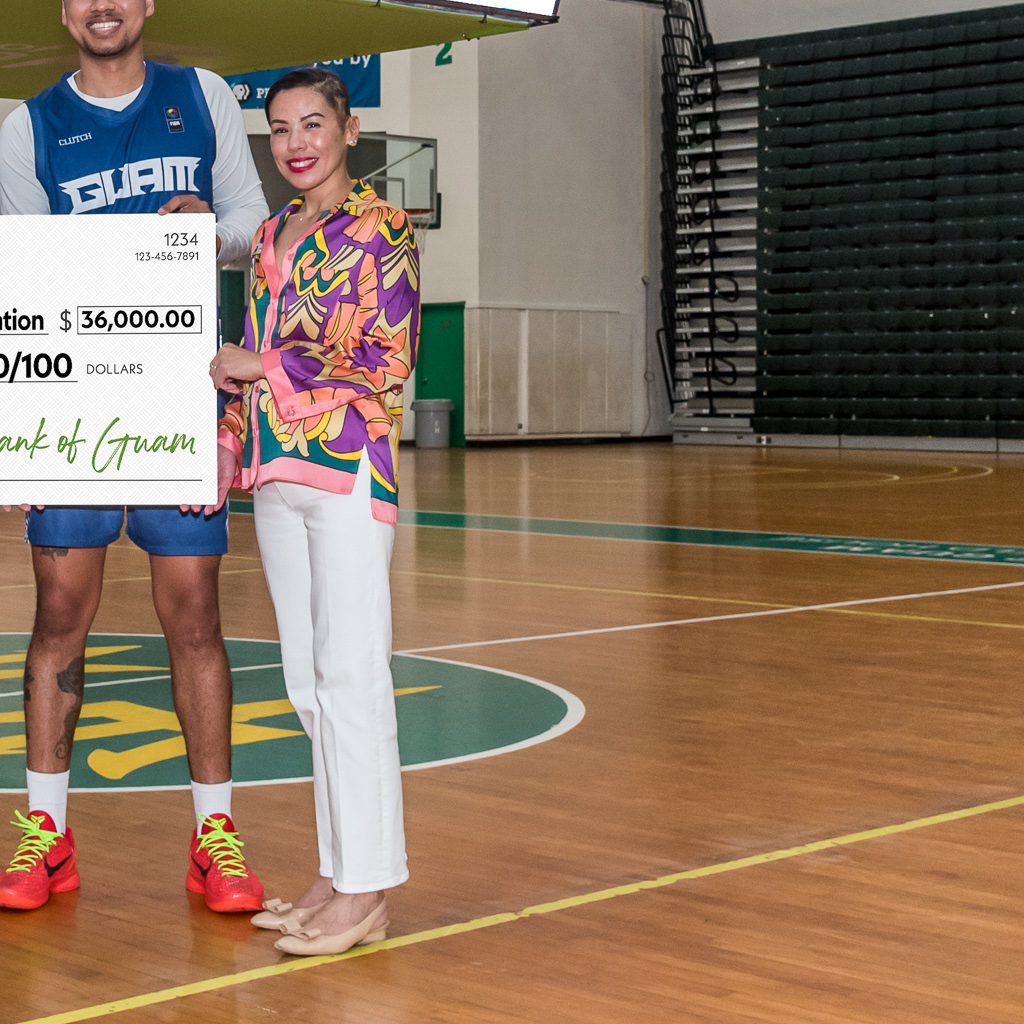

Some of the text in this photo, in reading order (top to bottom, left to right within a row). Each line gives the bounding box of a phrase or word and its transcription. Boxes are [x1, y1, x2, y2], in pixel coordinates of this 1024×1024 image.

[435, 42, 453, 67] 2
[58, 132, 93, 146] CLUTCH
[58, 156, 202, 215] GUAM
[164, 232, 199, 247] 1234
[135, 251, 199, 262] 123-456-7891
[59, 308, 195, 333] $ 36,000.00
[86, 363, 143, 375] DOLLARS
[57, 418, 87, 465] of
[92, 416, 196, 474] Guam
